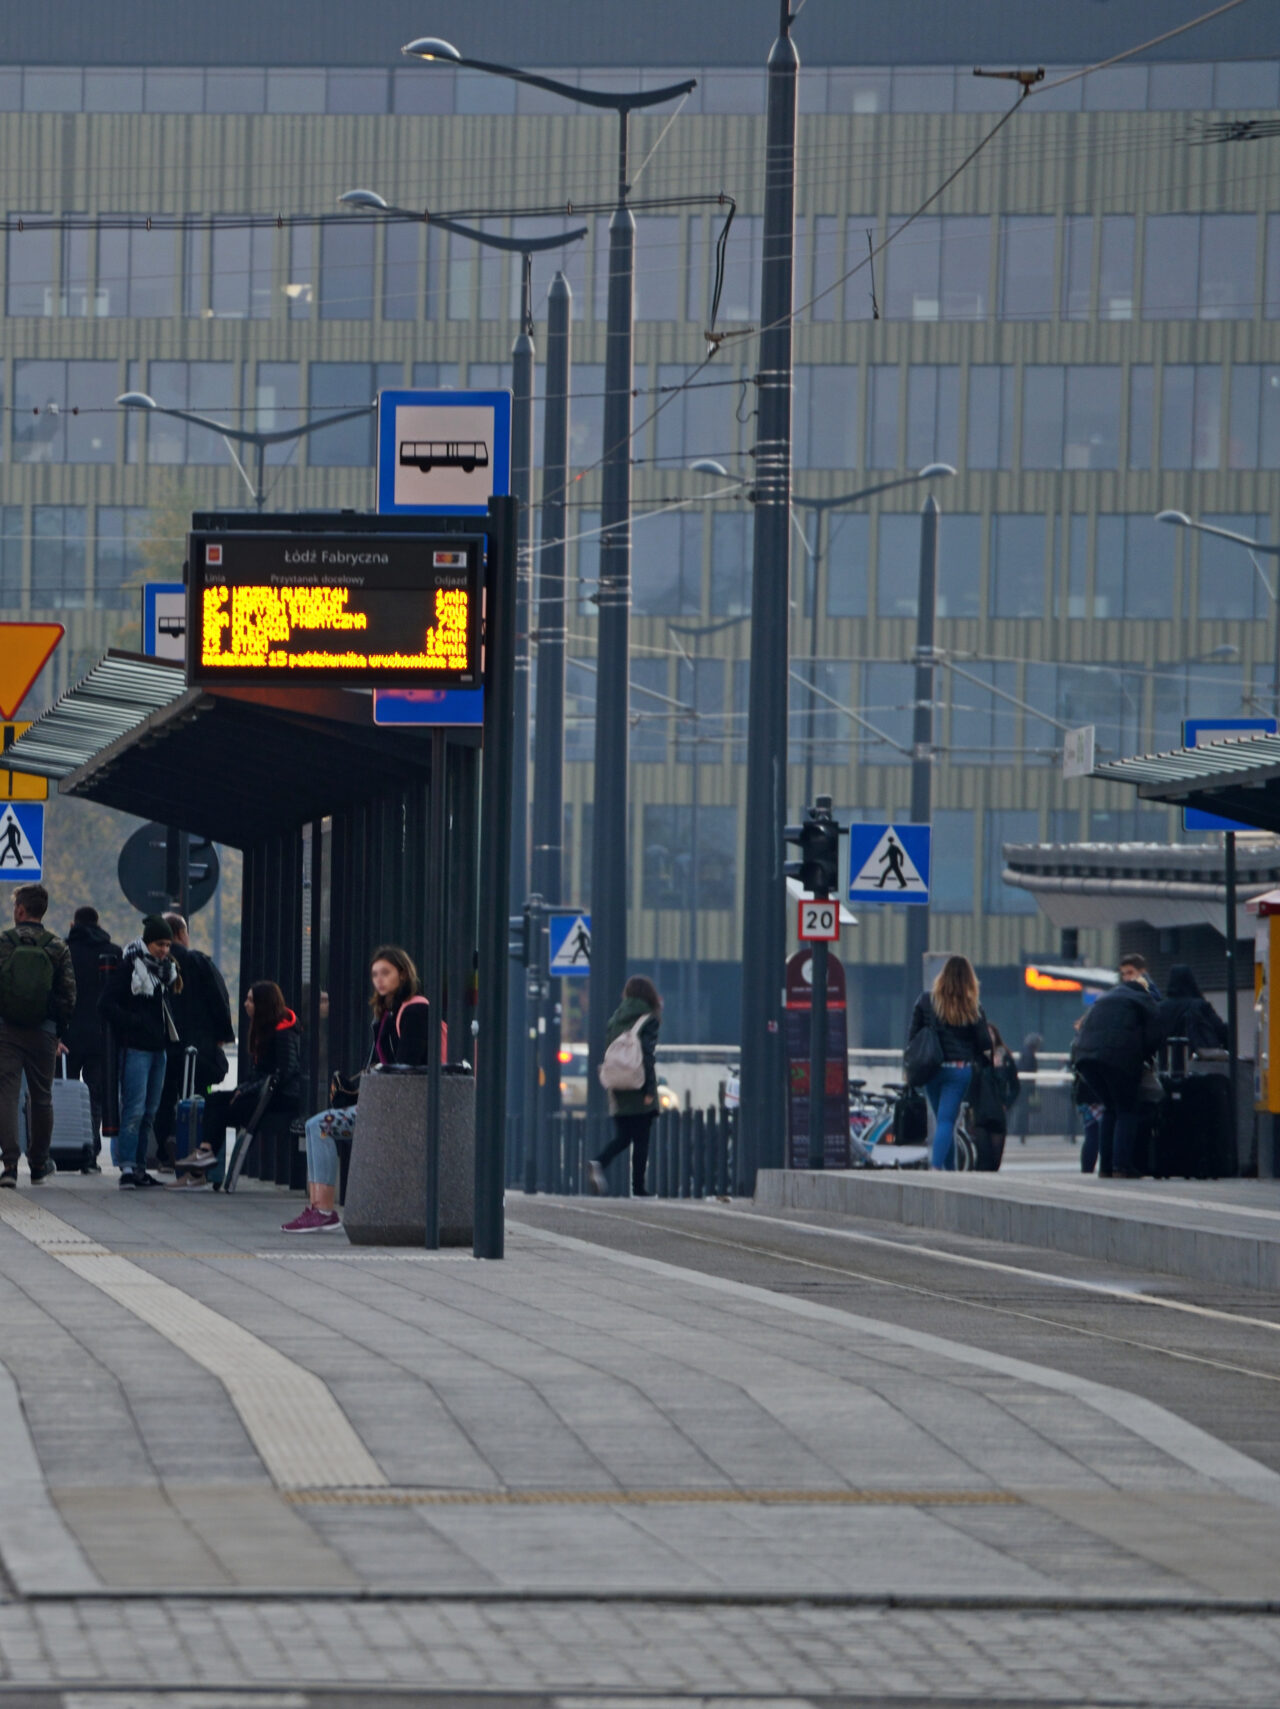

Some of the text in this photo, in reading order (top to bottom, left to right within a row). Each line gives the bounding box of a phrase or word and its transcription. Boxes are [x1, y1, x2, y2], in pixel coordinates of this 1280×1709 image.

[284, 549, 389, 567] Łódź Fabryczna
[204, 573, 226, 584] Linia
[271, 573, 365, 587] Przystanek docelowy
[434, 574, 467, 587] Odjazd
[268, 651, 287, 667] 15
[807, 910, 834, 929] 20
